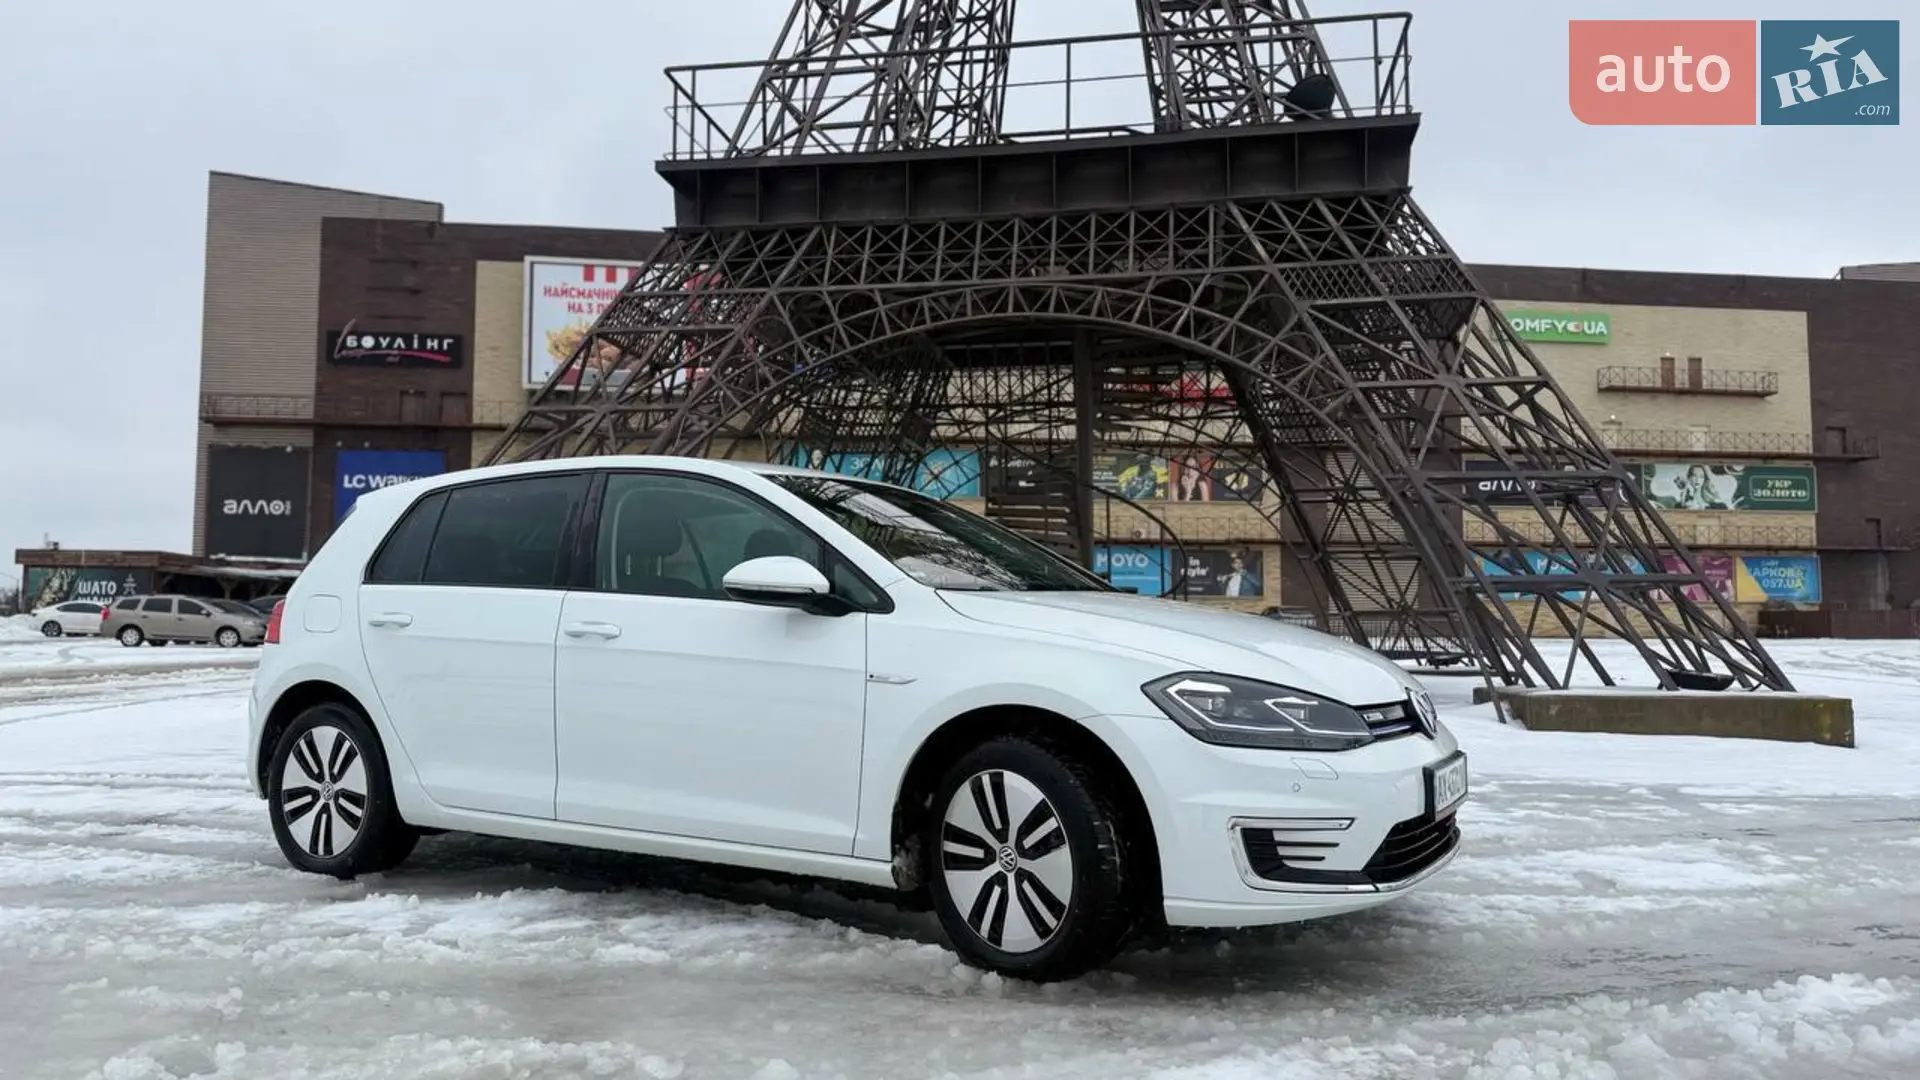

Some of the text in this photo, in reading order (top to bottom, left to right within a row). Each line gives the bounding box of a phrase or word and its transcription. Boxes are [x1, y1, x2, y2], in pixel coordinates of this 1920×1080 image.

[1509, 318, 1567, 333] OMFY
[345, 333, 454, 350] БОУЛІНГ
[342, 474, 366, 488] LC
[1767, 479, 1793, 489] УКР
[1753, 488, 1806, 498] ЗОЛОТО
[78, 581, 117, 595] ШАТО
